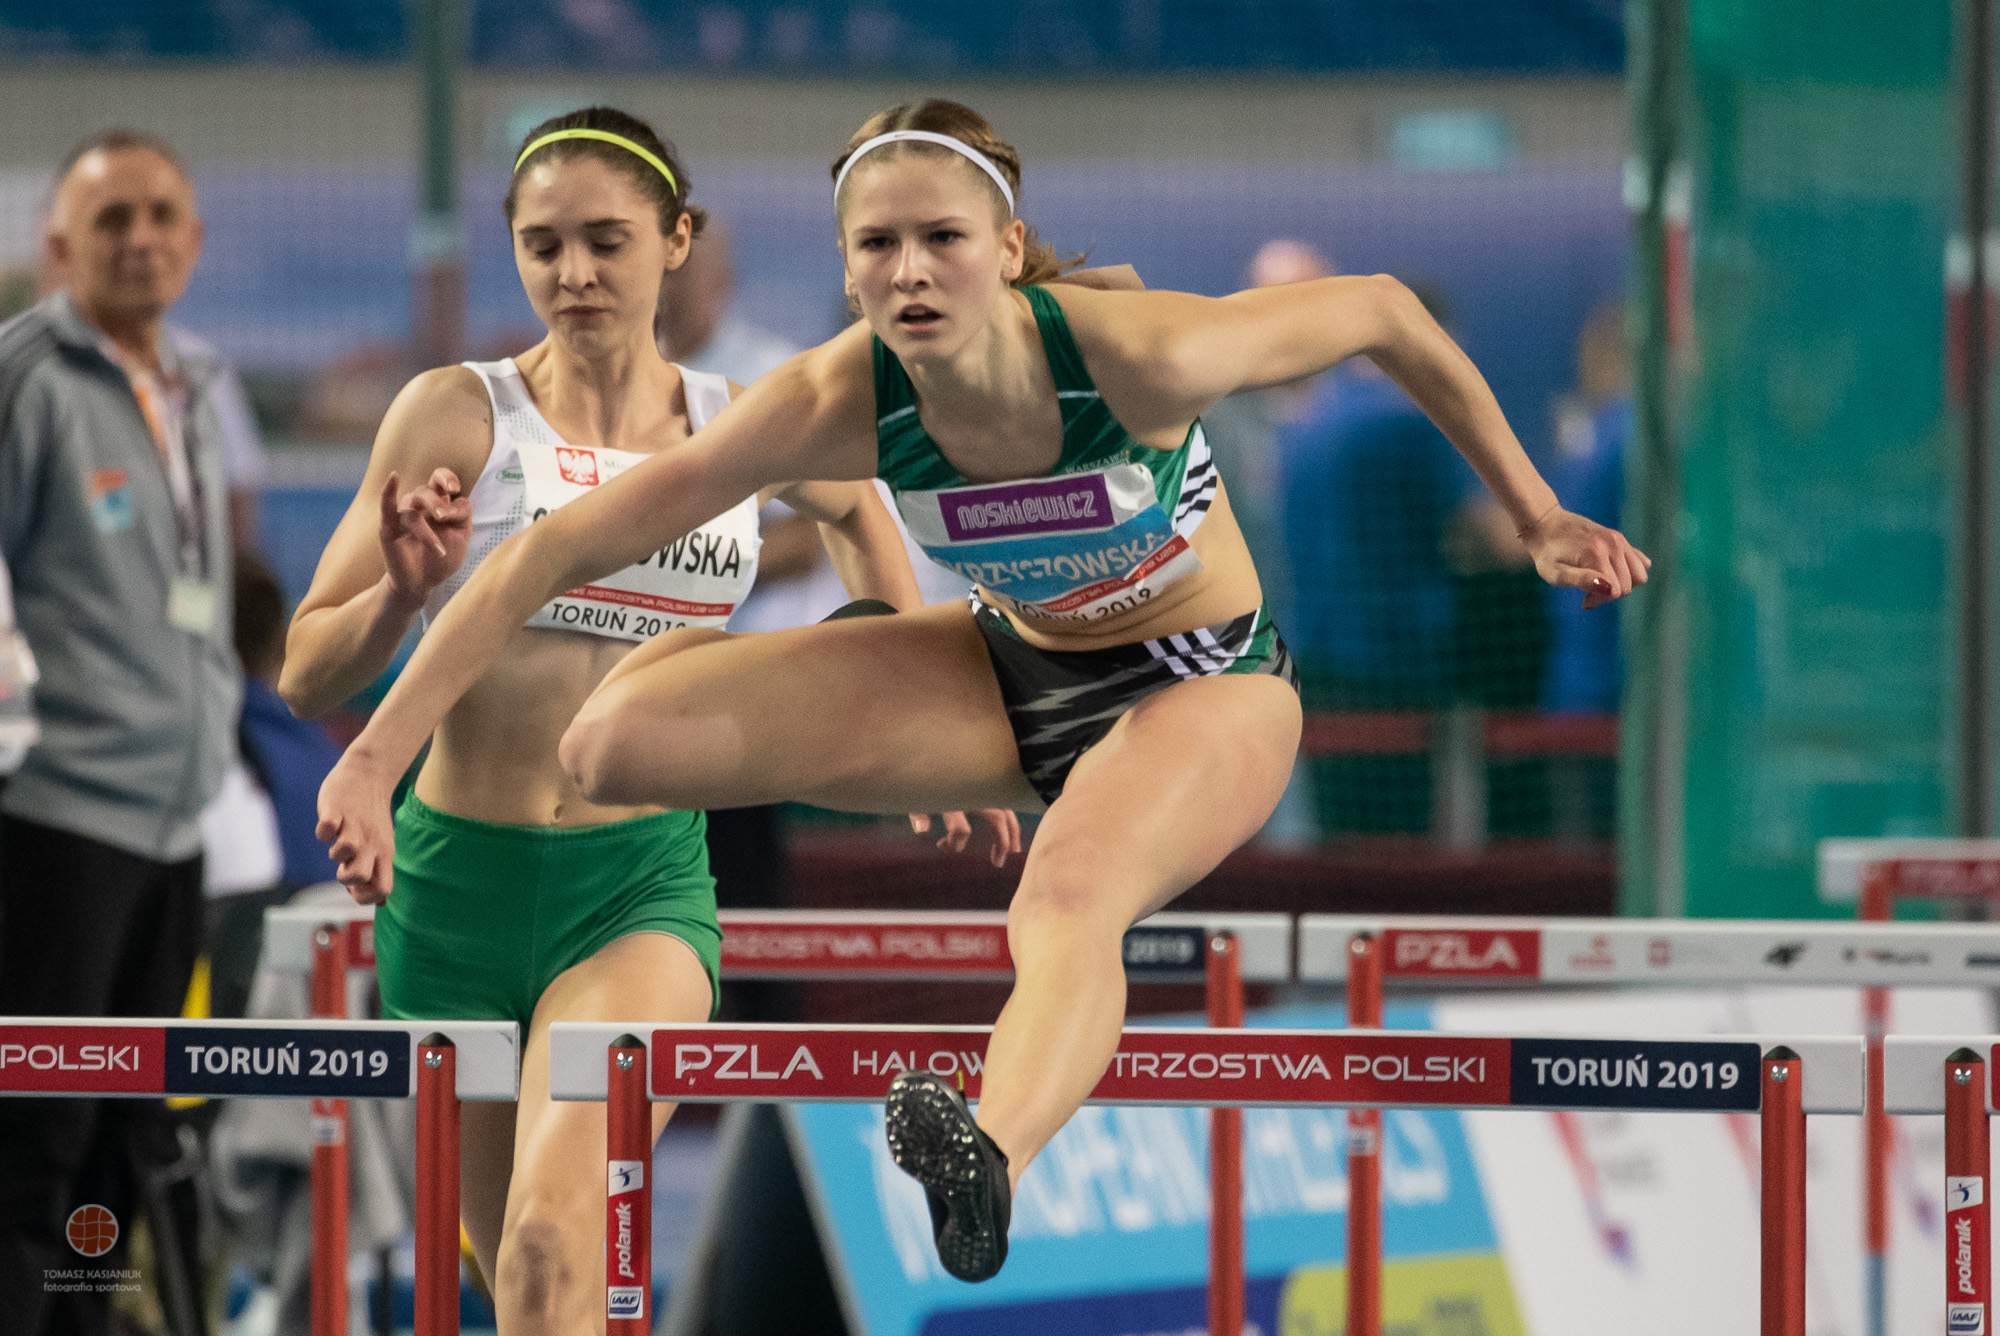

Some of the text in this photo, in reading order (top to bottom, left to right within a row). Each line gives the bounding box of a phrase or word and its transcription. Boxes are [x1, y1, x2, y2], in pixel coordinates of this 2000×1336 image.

[957, 490, 1099, 531] noskiewicz
[551, 603, 687, 637] TORUŃ 201
[1396, 933, 1520, 970] PZLA
[0, 1042, 389, 1077] POLSKI TORUŃ 2019
[675, 1045, 824, 1080] PZLA
[1113, 1052, 1332, 1081] TRZOSTWA
[1343, 1054, 1486, 1083] POLSKI
[1532, 1054, 1648, 1088] TORUŃ
[1657, 1060, 1740, 1090] 2019
[615, 1201, 635, 1279] polanik
[1954, 1217, 1976, 1296] polanik
[611, 1295, 638, 1306] IAAF
[1951, 1312, 1978, 1322] IAAF
